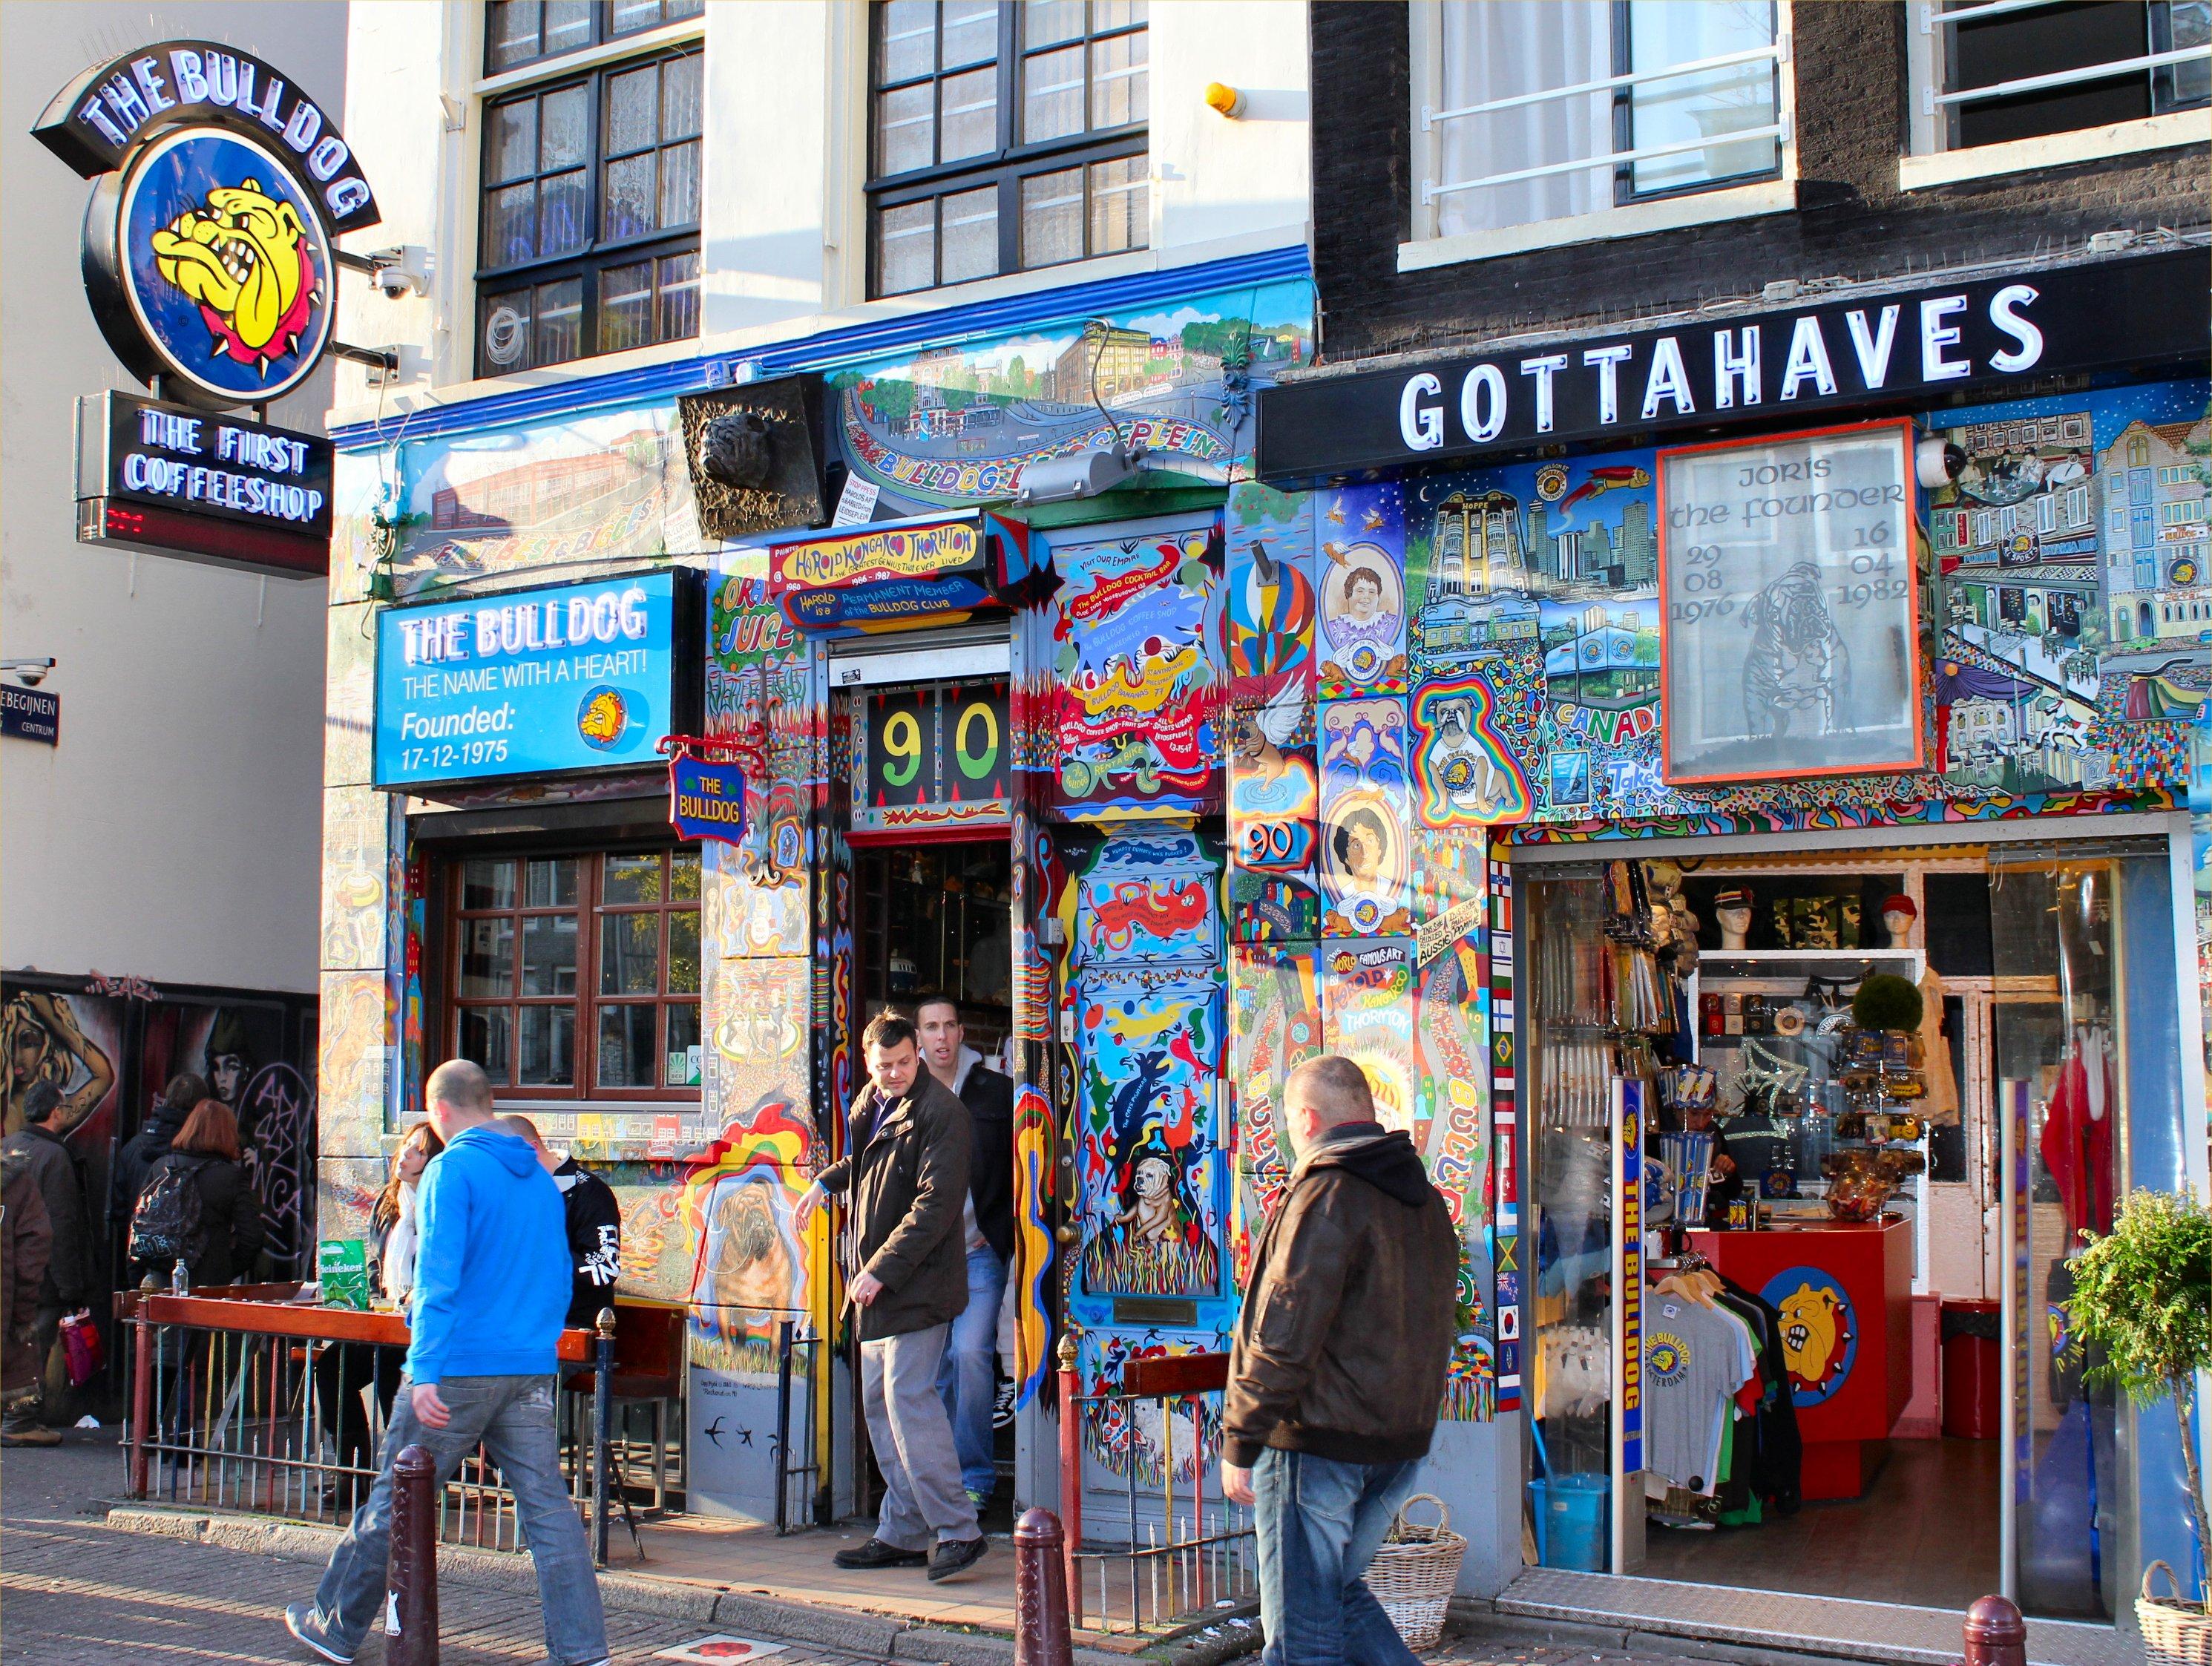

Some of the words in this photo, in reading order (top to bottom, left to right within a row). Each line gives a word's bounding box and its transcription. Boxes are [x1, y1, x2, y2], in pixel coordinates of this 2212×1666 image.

[78, 54, 176, 151] THE
[170, 49, 371, 220] BULLDOG
[139, 408, 202, 454] THE
[217, 425, 309, 475] FIRST
[876, 452, 1001, 492] BULLDOG
[123, 453, 323, 522] COFFEESHOP
[1462, 502, 1489, 510] HOPPE
[1671, 499, 1731, 531] the
[1854, 520, 1891, 549] 16
[2005, 531, 2016, 542] THE
[2015, 526, 2037, 540] BULLDOG
[496, 537, 558, 563] BEST
[775, 545, 799, 557] PAINTED
[1080, 558, 1096, 571] VISIT
[1096, 554, 1112, 565] OUR
[1112, 553, 1140, 567] EMPIRE
[1686, 545, 1723, 570] 29
[2012, 546, 2038, 562] SPORTS
[834, 571, 846, 579] THE
[879, 557, 902, 569] GENIUS
[916, 561, 936, 573] EVER
[942, 557, 963, 565] LIVED
[1850, 554, 1894, 580] 04
[787, 583, 801, 591] 1980
[852, 576, 867, 586] 1986
[875, 571, 890, 581] 1987
[1077, 598, 1090, 610] The
[1090, 580, 1123, 603] BULLDOG
[1124, 571, 1158, 584] COCKTAIL
[1160, 560, 1172, 574] BAR
[1684, 570, 1723, 592] 08
[1837, 578, 1909, 609] 1982
[800, 592, 836, 614] HAROLD
[842, 585, 911, 605] PERMANENT
[913, 580, 965, 596] MEMBER
[844, 607, 855, 617] of
[856, 605, 868, 615] the
[868, 600, 919, 614] BULLDOG
[923, 600, 950, 610] CLUB
[1671, 594, 1736, 626] 1976
[398, 614, 470, 666] THE
[476, 588, 648, 657] BULLDOG
[720, 611, 795, 655] JUICE
[1093, 623, 1126, 647] BULLDOG
[1129, 611, 1156, 626] COFFEE
[1157, 607, 1177, 620] SHOP
[402, 675, 440, 701] THE
[444, 668, 497, 696] NAME
[502, 660, 551, 689] WITH
[555, 657, 571, 683] A
[574, 650, 647, 681] HEART!
[1092, 680, 1120, 706] BULLDOG
[1118, 689, 1149, 699] BANANAS
[22, 721, 55, 737] CENTRUM
[401, 702, 516, 741] Founded:
[1060, 721, 1086, 734] BULLDOG
[1086, 728, 1105, 736] COFFEE
[1152, 721, 1175, 732] SPORTS
[1175, 714, 1193, 729] WEAR
[1158, 717, 1168, 725] ALL
[1063, 732, 1080, 744] Palace
[1155, 729, 1188, 741] LEIDSEPLEIN
[401, 740, 508, 771] 17-12-1975
[1094, 759, 1115, 775] RENT
[1123, 745, 1144, 763] BIKE
[1438, 757, 1448, 772] THE
[1448, 750, 1477, 762] BULLDOG
[699, 776, 722, 796] THE
[1607, 761, 1655, 798] Take
[679, 795, 740, 823] BULLDOG
[1112, 846, 1132, 855] HUMPTY
[1132, 846, 1152, 856] DUMPTY
[1248, 822, 1293, 862] 90
[1418, 931, 1443, 943] PAINTED
[1453, 917, 1479, 937] POMMIE
[1330, 954, 1357, 972] WORLD
[1359, 948, 1386, 966] FAMOUS
[1385, 948, 1403, 962] ART
[1420, 934, 1451, 964] AUSSIE
[1344, 1010, 1411, 1034] THORNTON
[1125, 1102, 1134, 1118] CATS
[1131, 1077, 1147, 1103] PYJAMAS
[1624, 1180, 1640, 1244] THE
[1624, 1253, 1640, 1411] BULLDOG
[1656, 1333, 1691, 1365] BULLDOG
